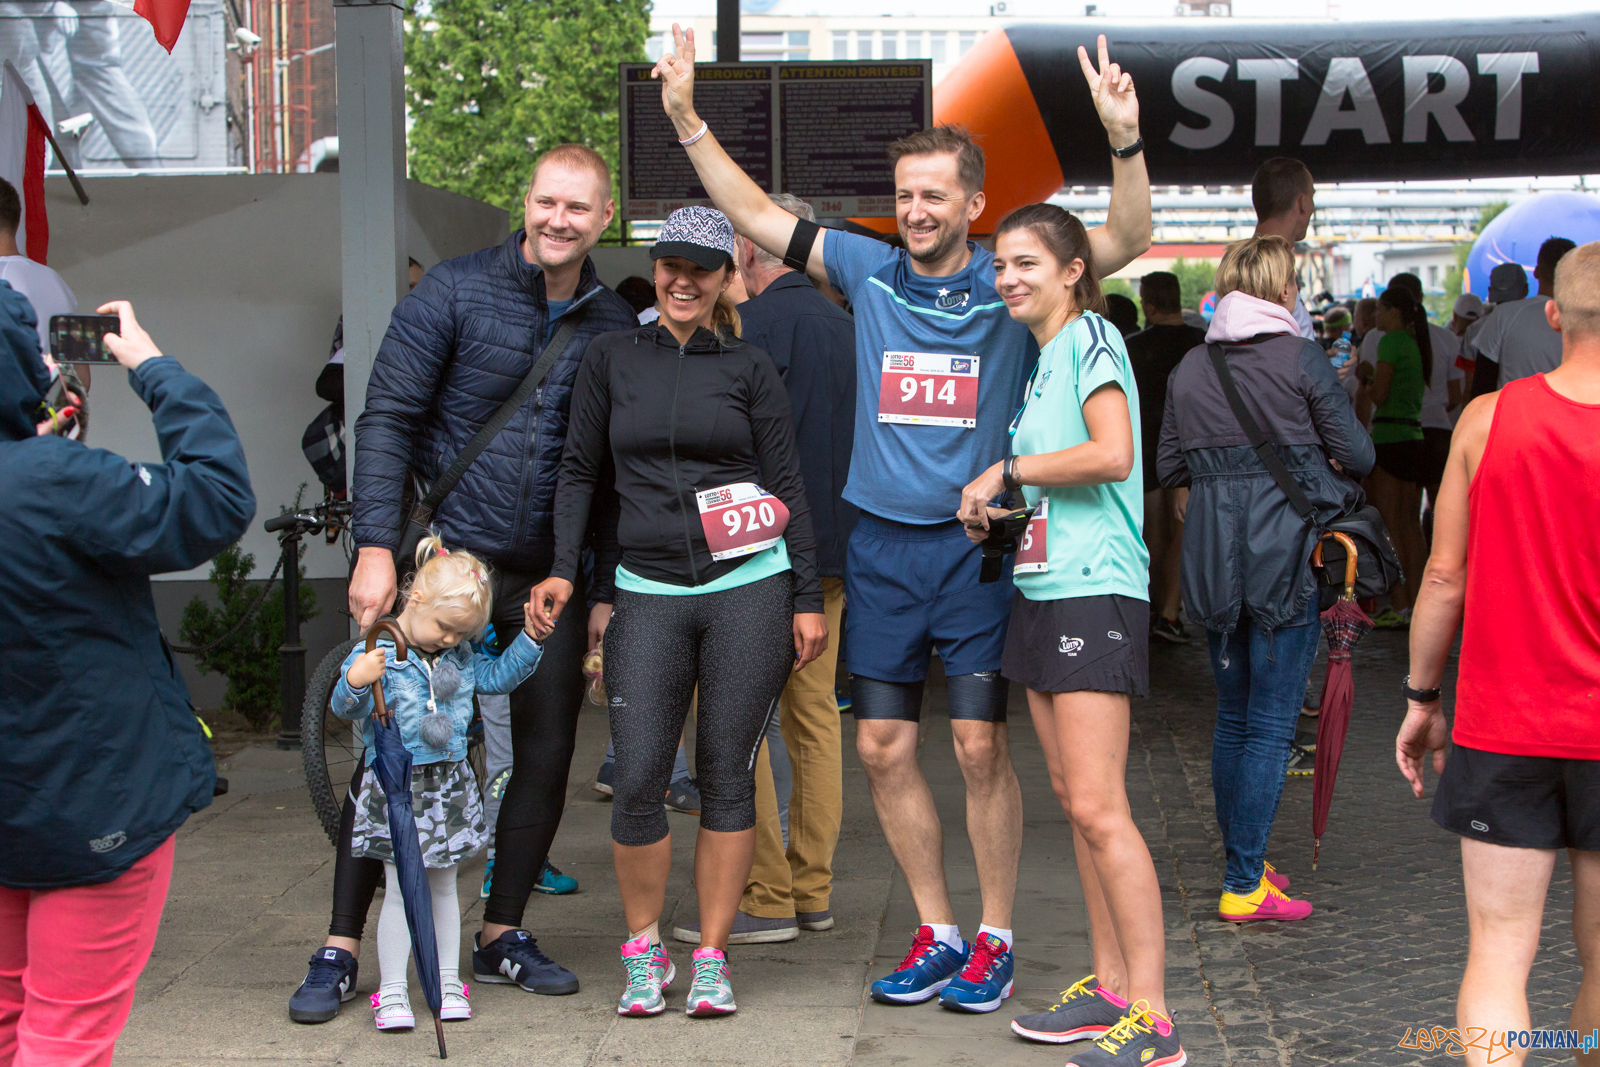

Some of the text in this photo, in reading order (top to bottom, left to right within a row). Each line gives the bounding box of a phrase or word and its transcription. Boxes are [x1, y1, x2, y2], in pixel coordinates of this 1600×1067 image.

[780, 66, 921, 78] ATTENTION DRIVERS!
[1168, 51, 1540, 150] START
[941, 294, 963, 307] LOTTO
[900, 376, 956, 405] 914
[722, 501, 775, 537] 920
